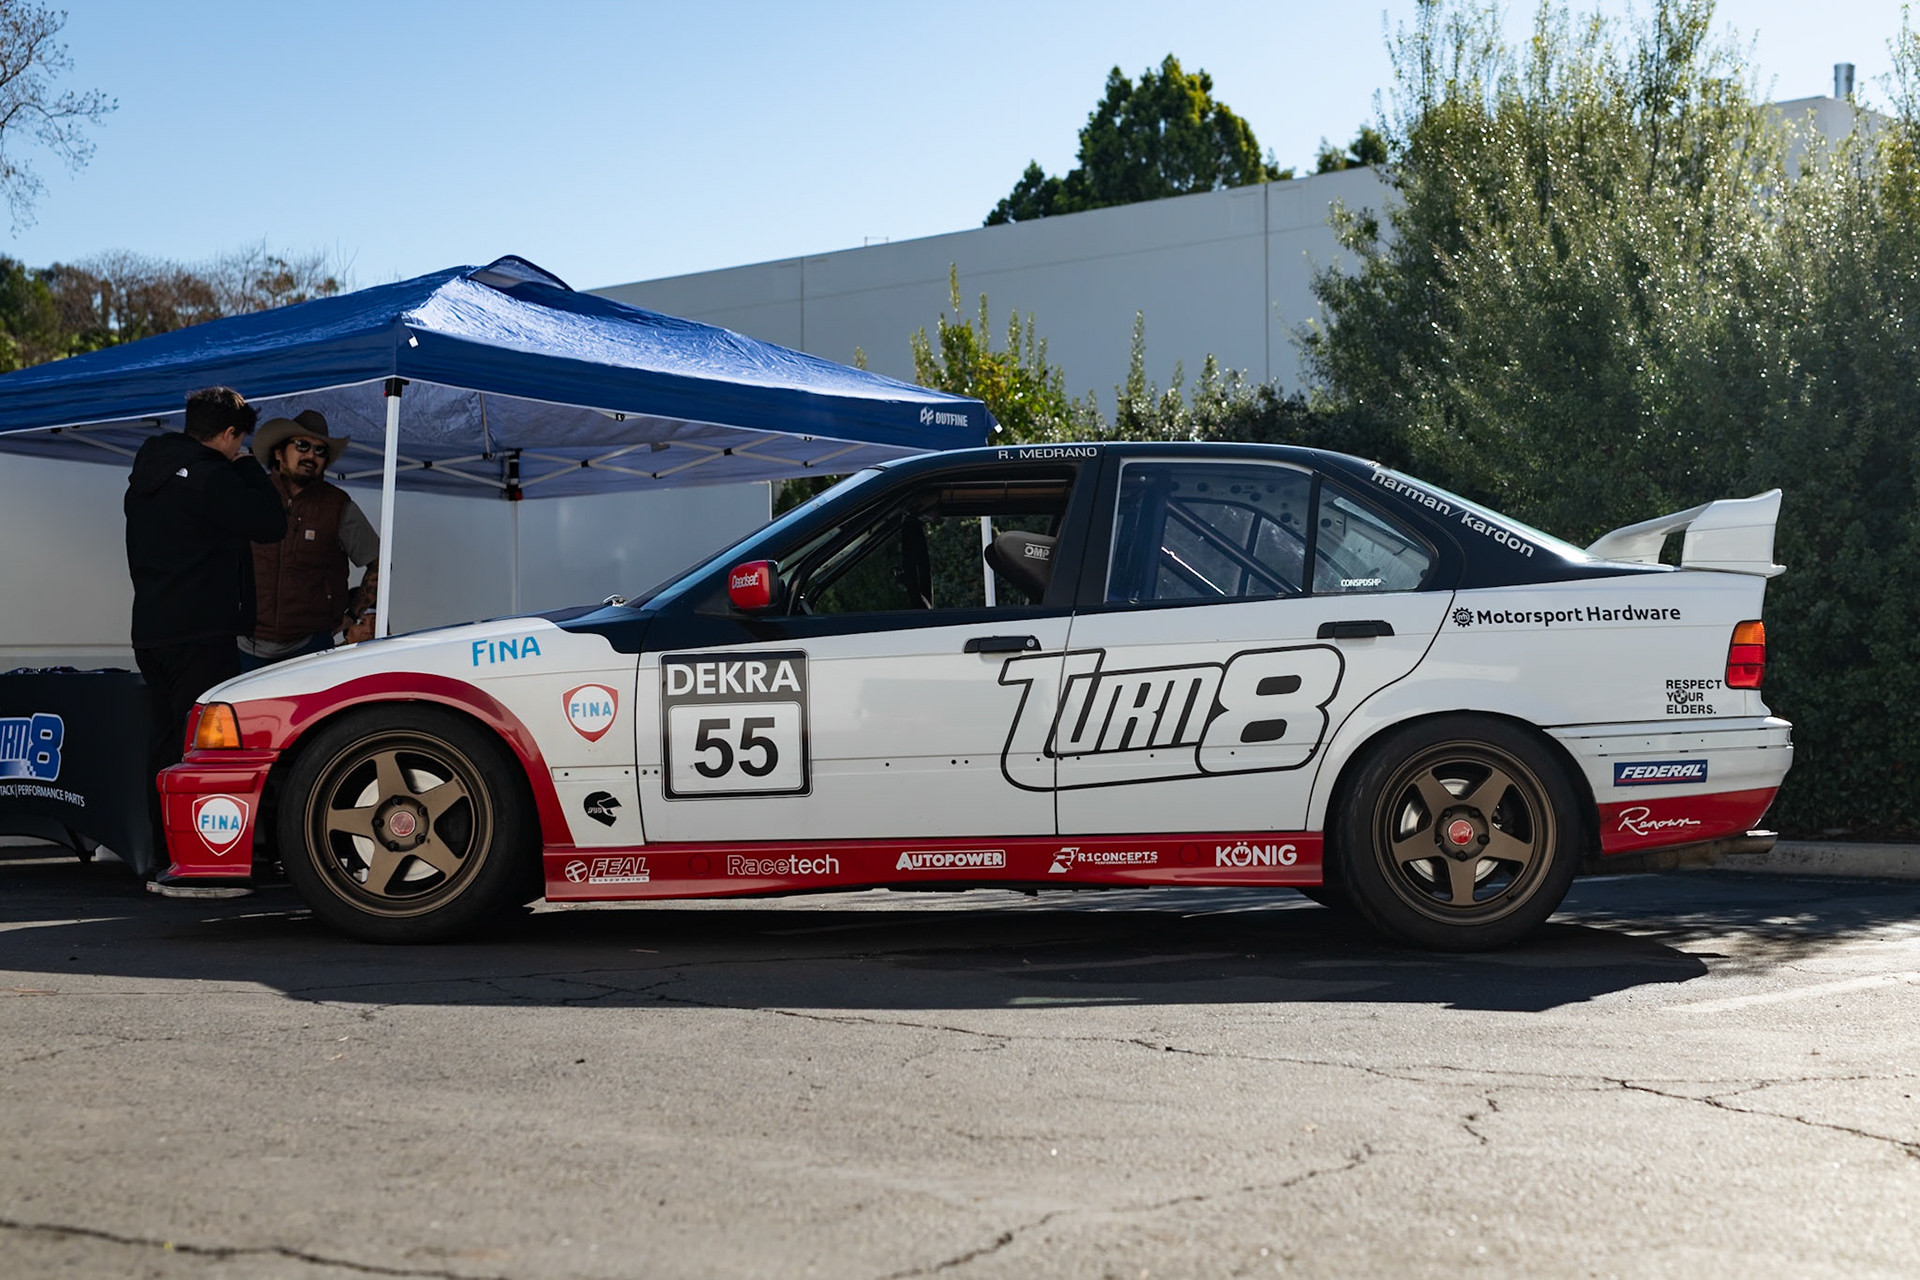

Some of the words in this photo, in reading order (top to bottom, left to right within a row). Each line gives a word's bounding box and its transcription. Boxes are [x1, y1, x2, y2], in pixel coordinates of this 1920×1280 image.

[935, 412, 968, 427] OUTFINE
[998, 450, 1014, 459] R.
[1019, 447, 1098, 458] MEDRANO
[1024, 546, 1050, 558] OMP
[1477, 608, 1582, 626] Motorsport
[1586, 604, 1681, 621] Hardware
[472, 636, 541, 667] FINA
[666, 660, 801, 696] DEKRA
[1666, 680, 1722, 690] RESPECT
[571, 701, 612, 718] FINA
[1666, 704, 1717, 714] ELDERS.
[694, 717, 779, 779] 55
[1620, 764, 1703, 779] FEDERAL
[18, 784, 64, 800] PERFORMANCE
[64, 791, 86, 807] PARTS
[201, 814, 240, 830] FINA
[1618, 807, 1701, 836] Renown
[728, 854, 839, 874] Racetech
[1216, 842, 1297, 867] KÖNIG
[589, 857, 650, 877] FEAL
